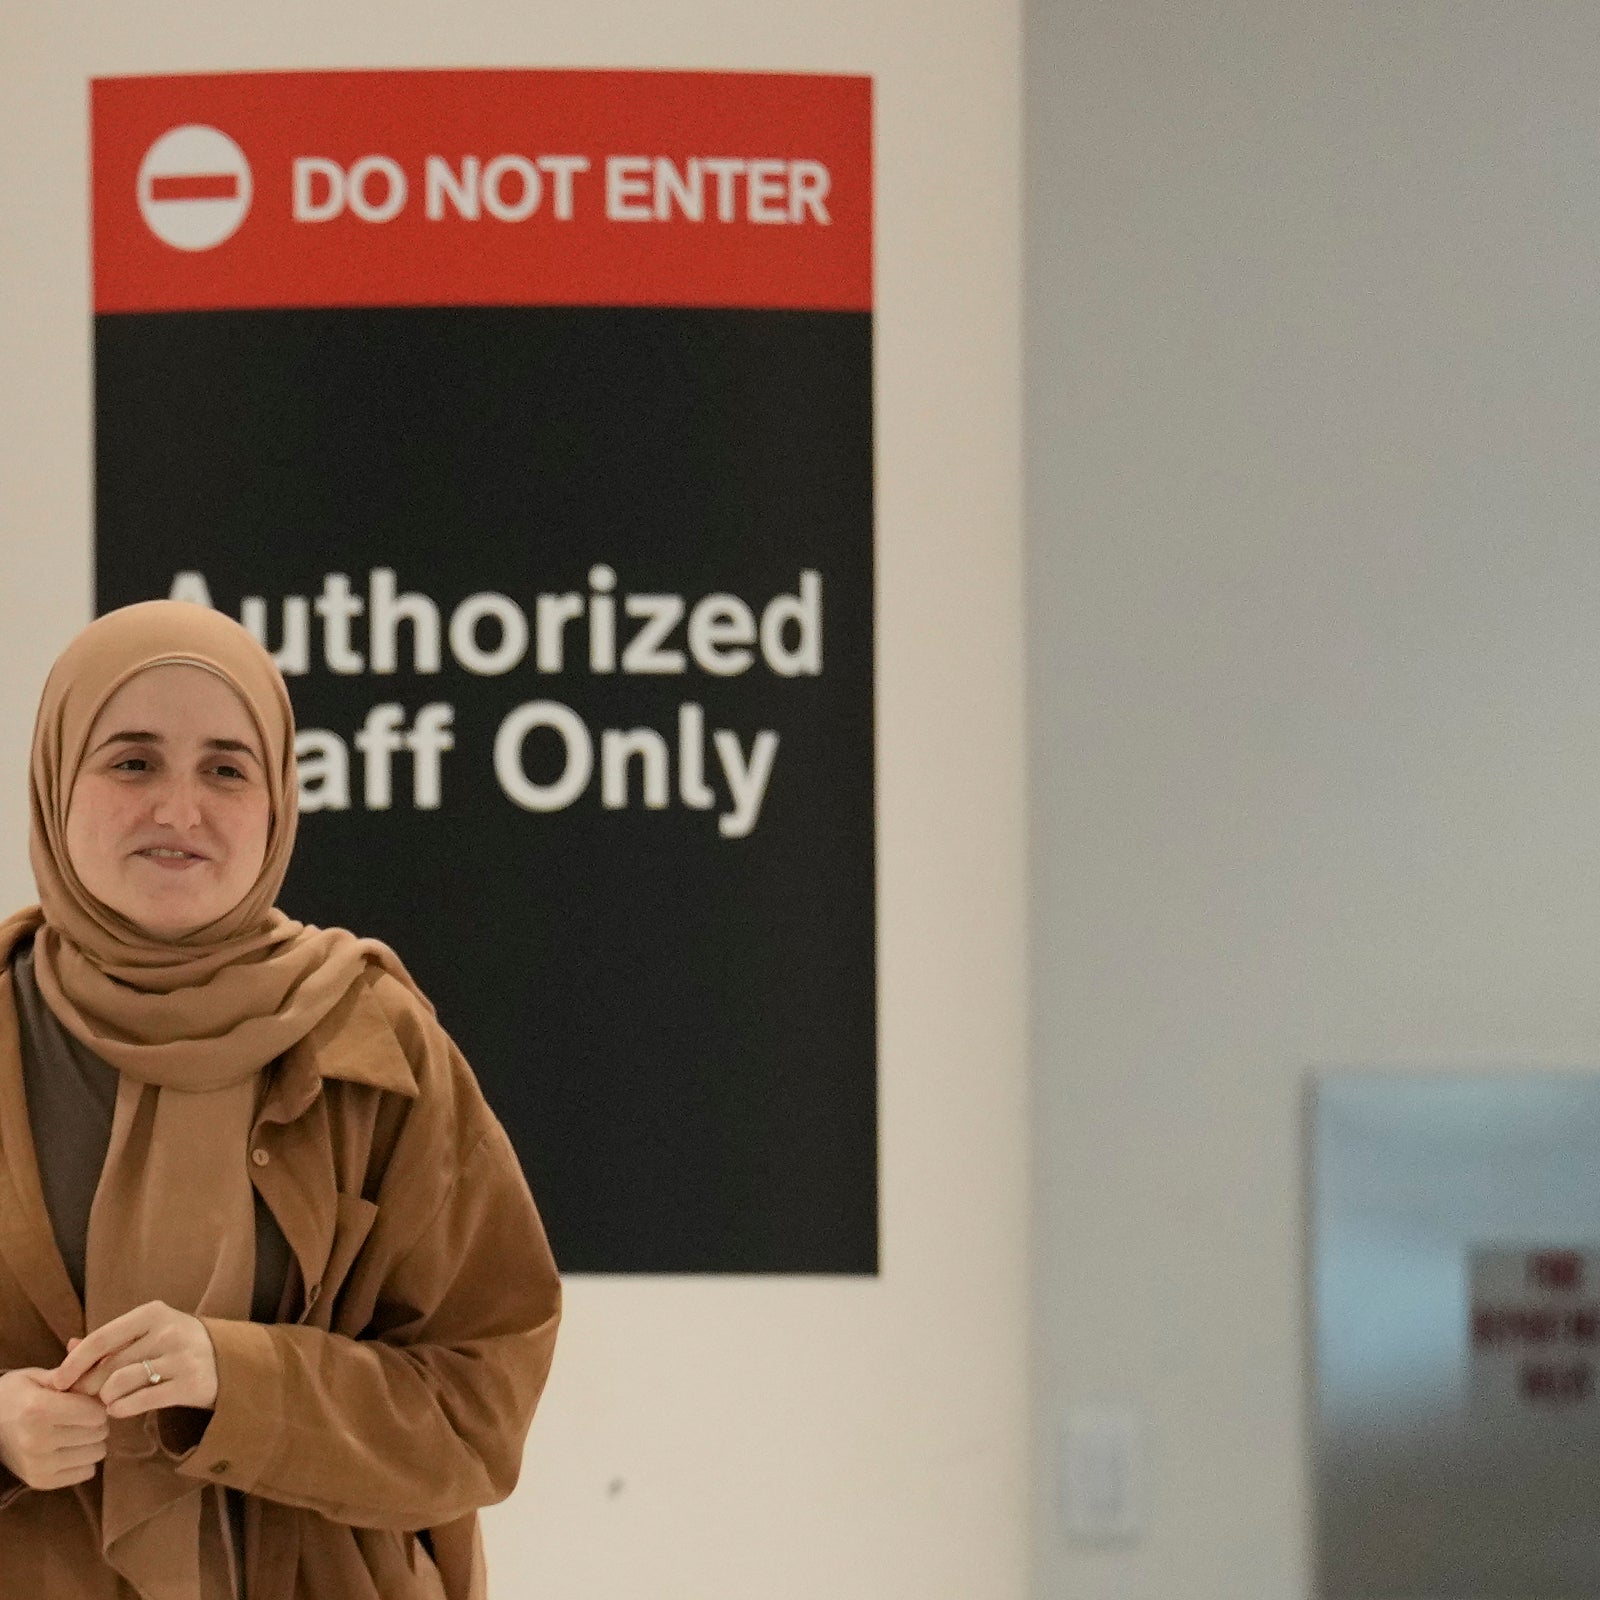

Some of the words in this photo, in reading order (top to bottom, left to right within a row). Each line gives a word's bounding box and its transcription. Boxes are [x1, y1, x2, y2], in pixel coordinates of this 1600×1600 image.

[293, 155, 408, 223] DO
[425, 155, 589, 223] NOT
[605, 156, 831, 226] ENTER
[294, 701, 455, 814] aff
[493, 700, 779, 838] Only
